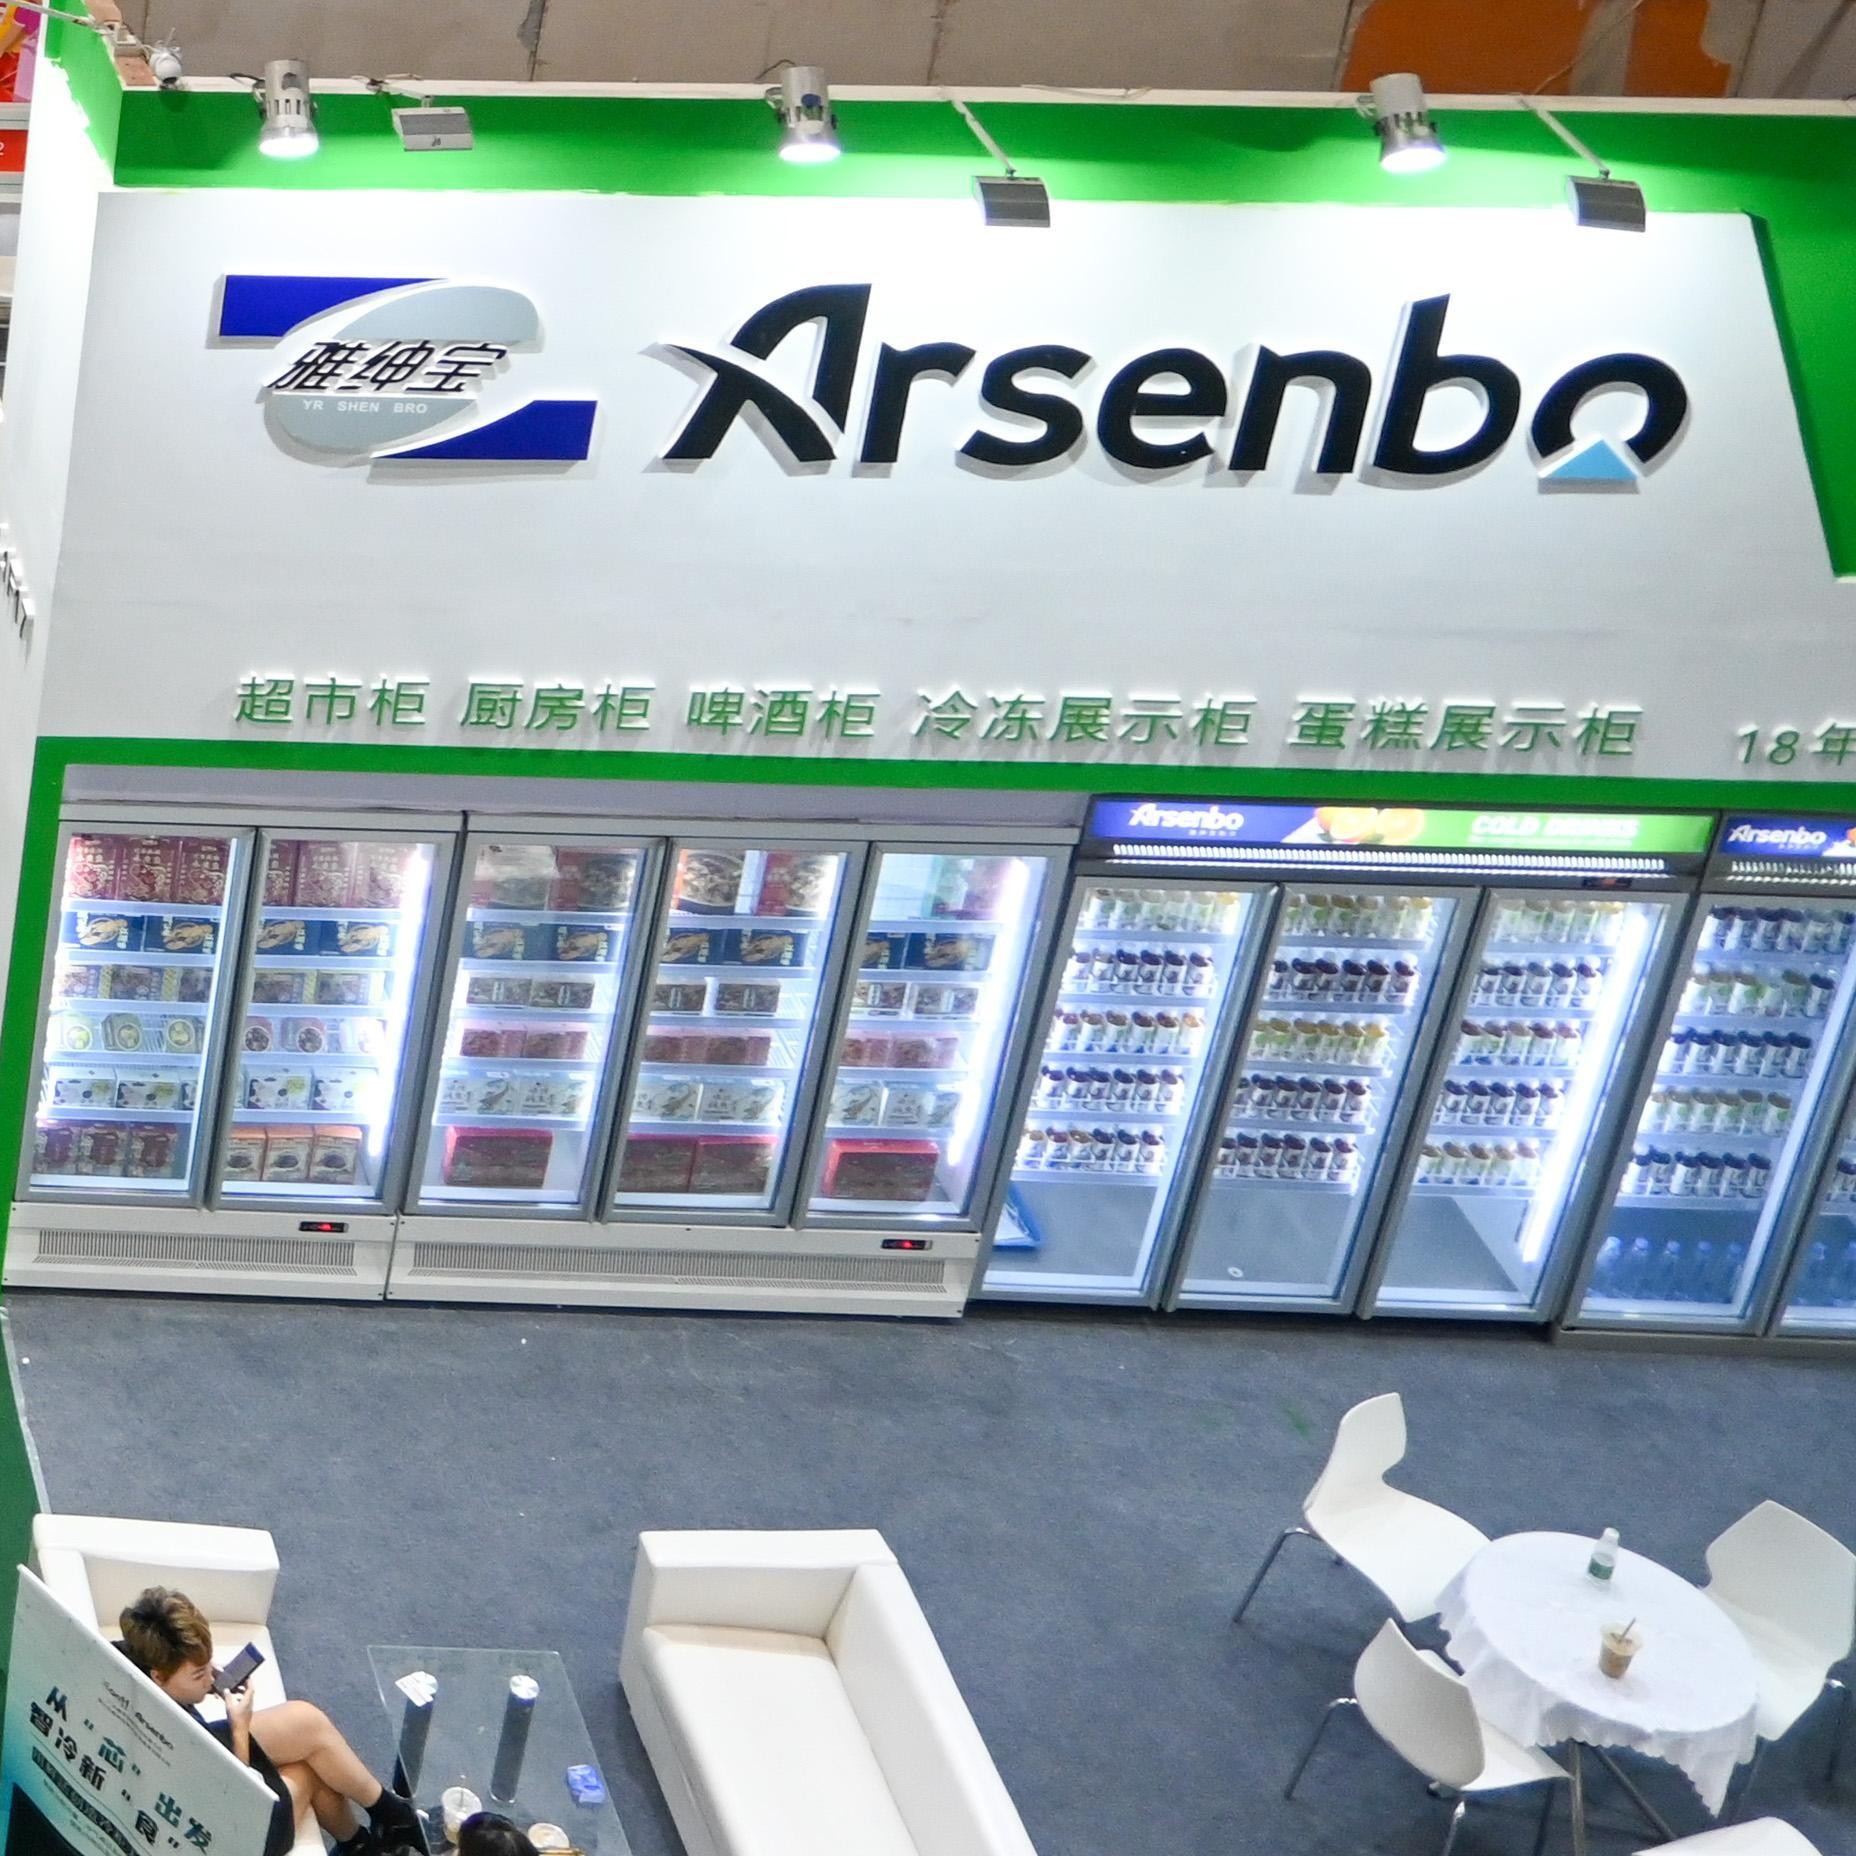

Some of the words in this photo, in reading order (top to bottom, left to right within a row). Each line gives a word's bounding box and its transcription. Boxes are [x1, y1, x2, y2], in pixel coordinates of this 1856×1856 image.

[272, 338, 510, 396] 雅绅宝
[661, 282, 1690, 481] Arsenbo
[301, 400, 324, 414] YR
[337, 400, 379, 415] SHEN
[393, 400, 428, 416] BRO
[234, 675, 430, 728] 超市柜
[459, 679, 655, 734] 厨房柜
[686, 684, 882, 742] 啤酒柜
[913, 689, 1258, 752] 冷冻展示柜
[1289, 697, 1643, 759] 蛋糕展示柜
[1128, 803, 1244, 833] Arsenbo
[1471, 814, 1541, 838] COLD
[1728, 824, 1827, 846] Arsenbo
